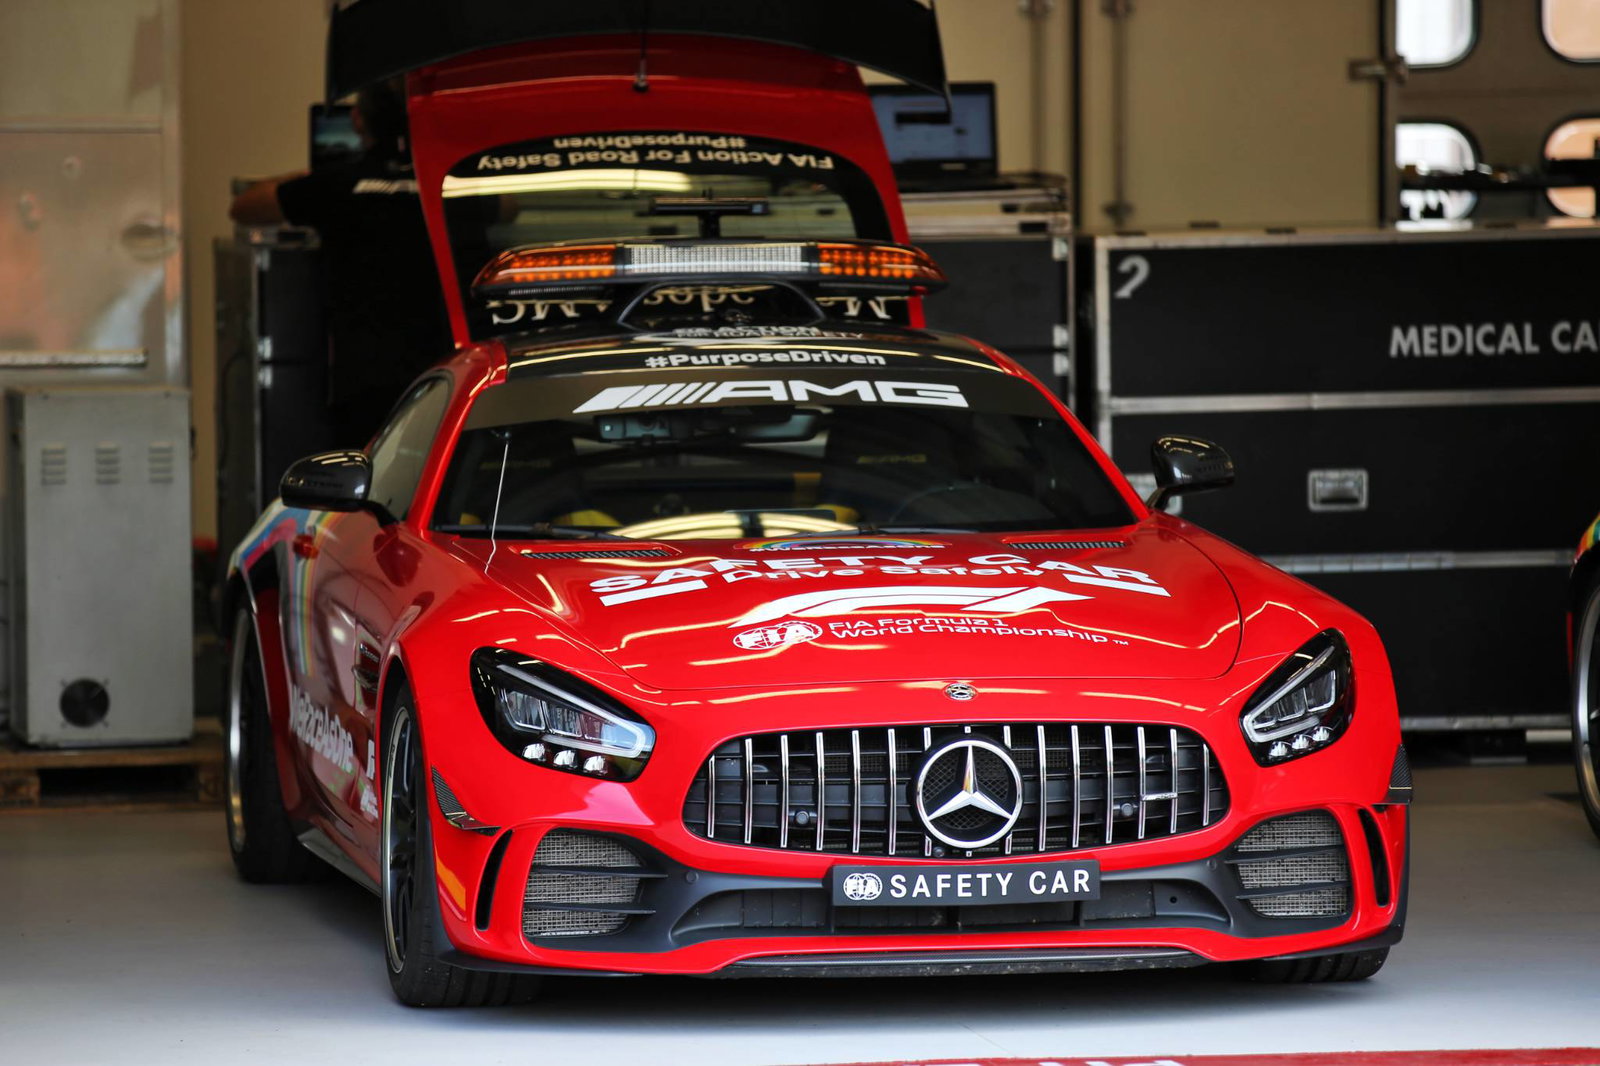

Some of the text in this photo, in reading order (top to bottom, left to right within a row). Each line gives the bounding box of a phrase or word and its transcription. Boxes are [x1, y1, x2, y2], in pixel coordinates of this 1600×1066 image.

[553, 133, 746, 149] #PurposeDriven
[477, 150, 834, 170] FIA Action For Road Safety
[1389, 320, 1600, 358] MEDICAL CA
[645, 350, 886, 369] #PurposeDriven
[700, 380, 969, 408] AMG
[589, 553, 1159, 593] SAFETY CAR
[721, 569, 864, 583] Drive
[828, 617, 1009, 631] FIA Formula 1
[830, 625, 913, 639] World
[918, 625, 1108, 643] Championship
[889, 872, 1013, 898] SAFETY
[1029, 870, 1091, 895] CAR
